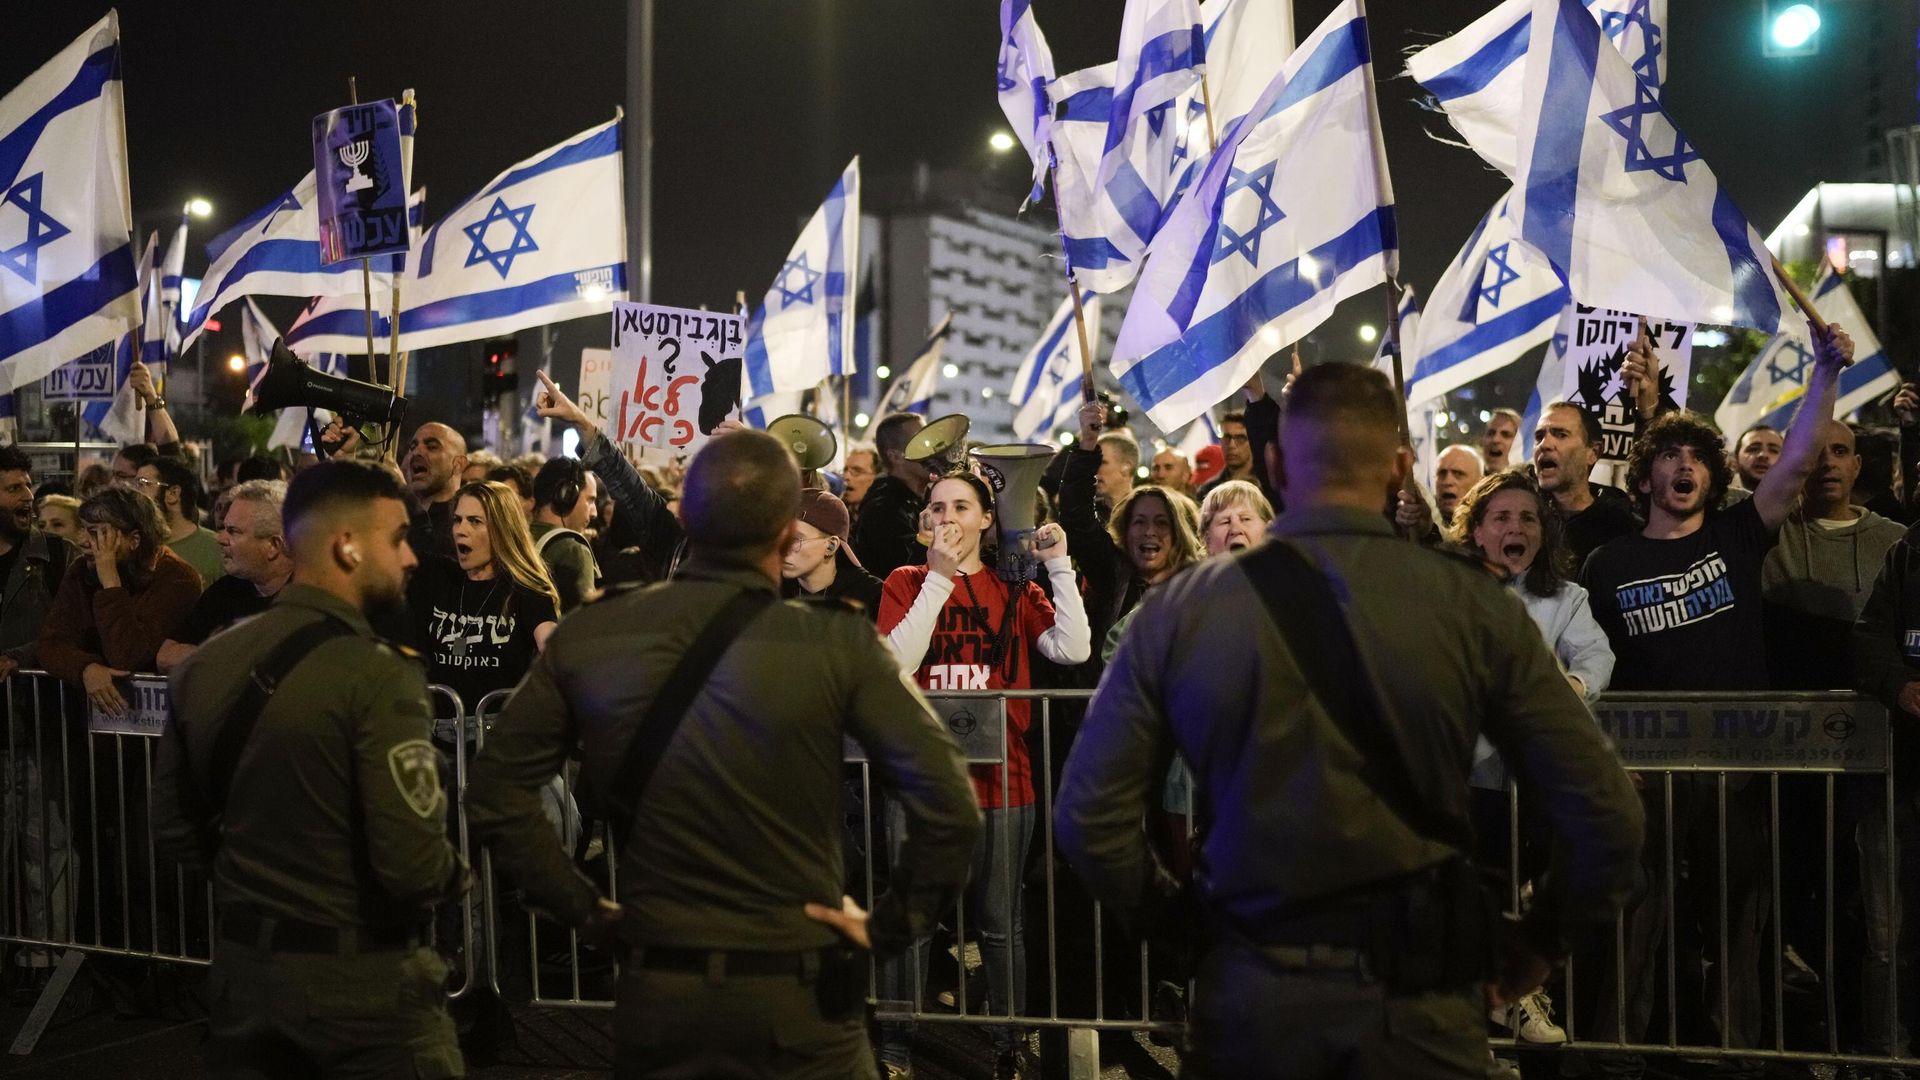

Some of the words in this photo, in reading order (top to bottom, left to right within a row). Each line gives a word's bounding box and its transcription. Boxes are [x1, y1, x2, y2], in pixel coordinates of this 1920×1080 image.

[338, 211, 402, 248] עכש
[574, 268, 612, 285] חופשי
[658, 337, 680, 381] ?
[51, 368, 108, 391] עכשיו!
[1662, 557, 1727, 597] חופשי
[1615, 582, 1665, 610] בארצנו
[1684, 576, 1735, 618] נתניה
[1622, 598, 1689, 637] והשרון
[929, 664, 991, 690] אתה
[1711, 710, 1811, 746] קשת
